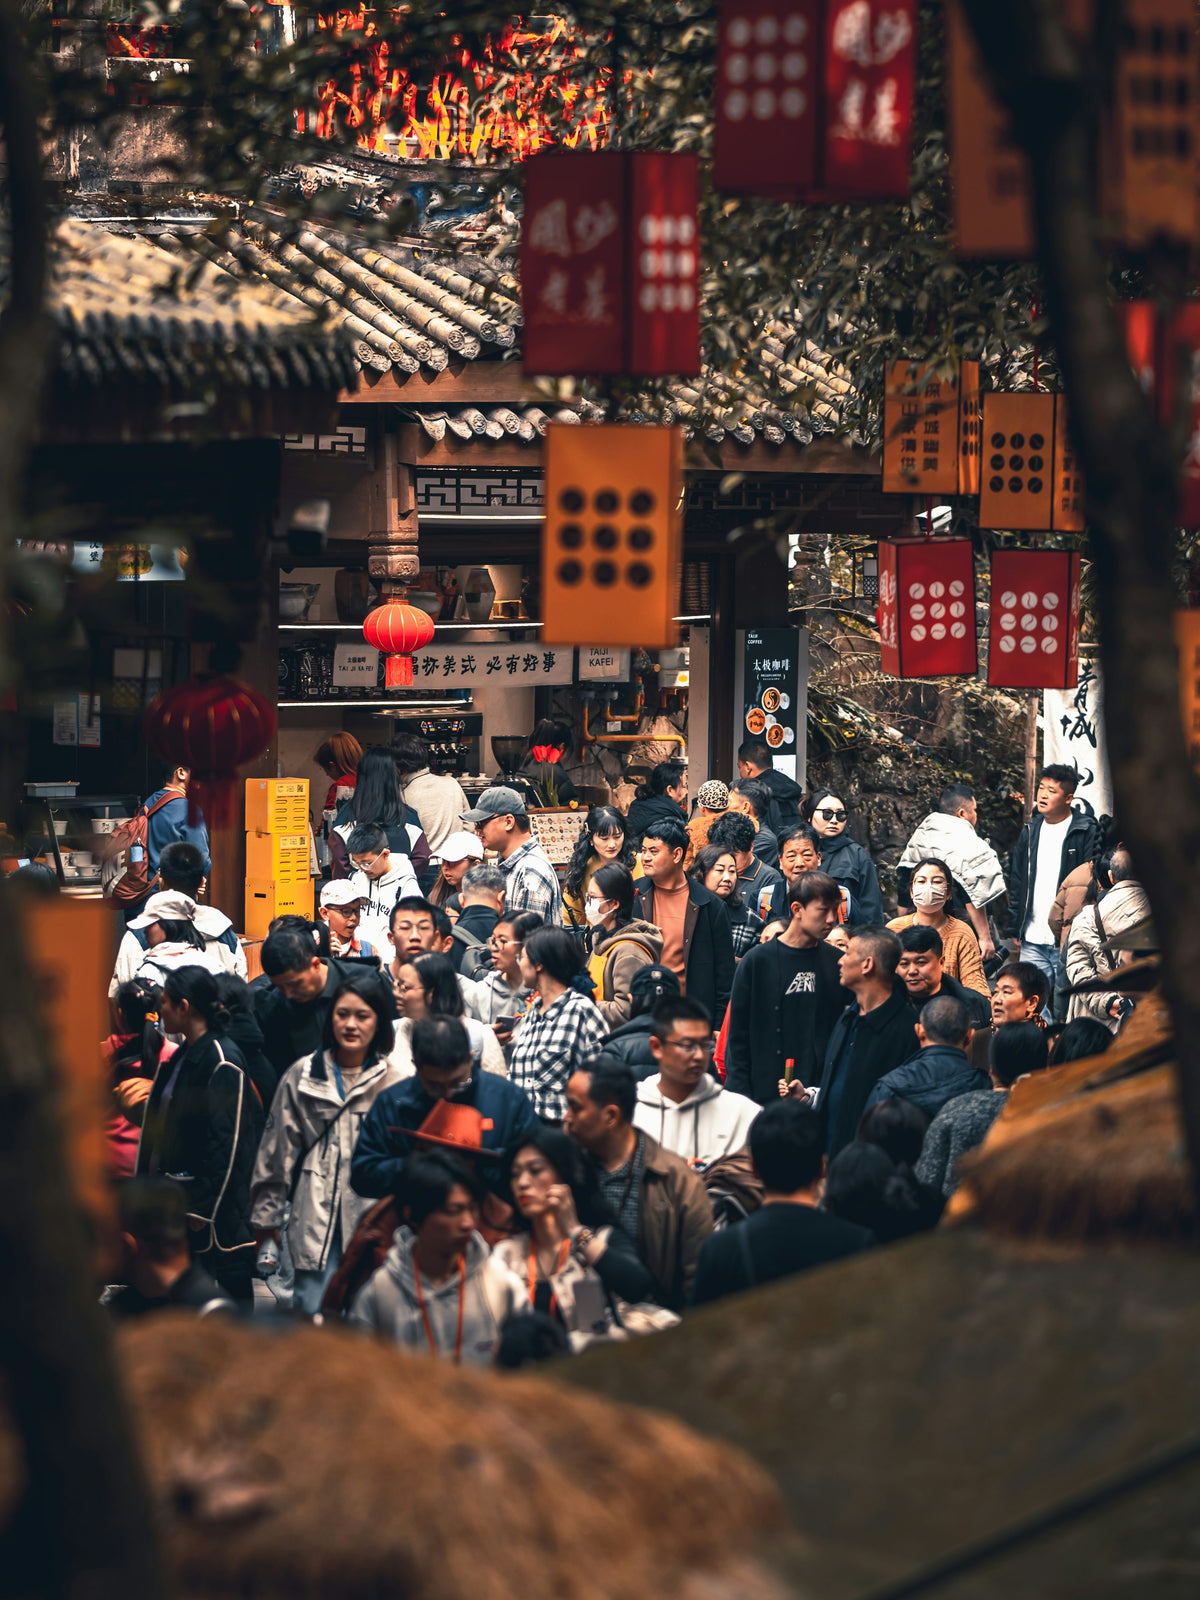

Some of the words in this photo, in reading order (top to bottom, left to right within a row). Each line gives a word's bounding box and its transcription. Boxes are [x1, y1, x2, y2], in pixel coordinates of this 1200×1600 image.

[589, 647, 609, 656] TAIJI
[486, 651, 556, 675] 必有好事
[589, 657, 614, 667] KAFEI
[752, 658, 791, 671] 太极咖啡
